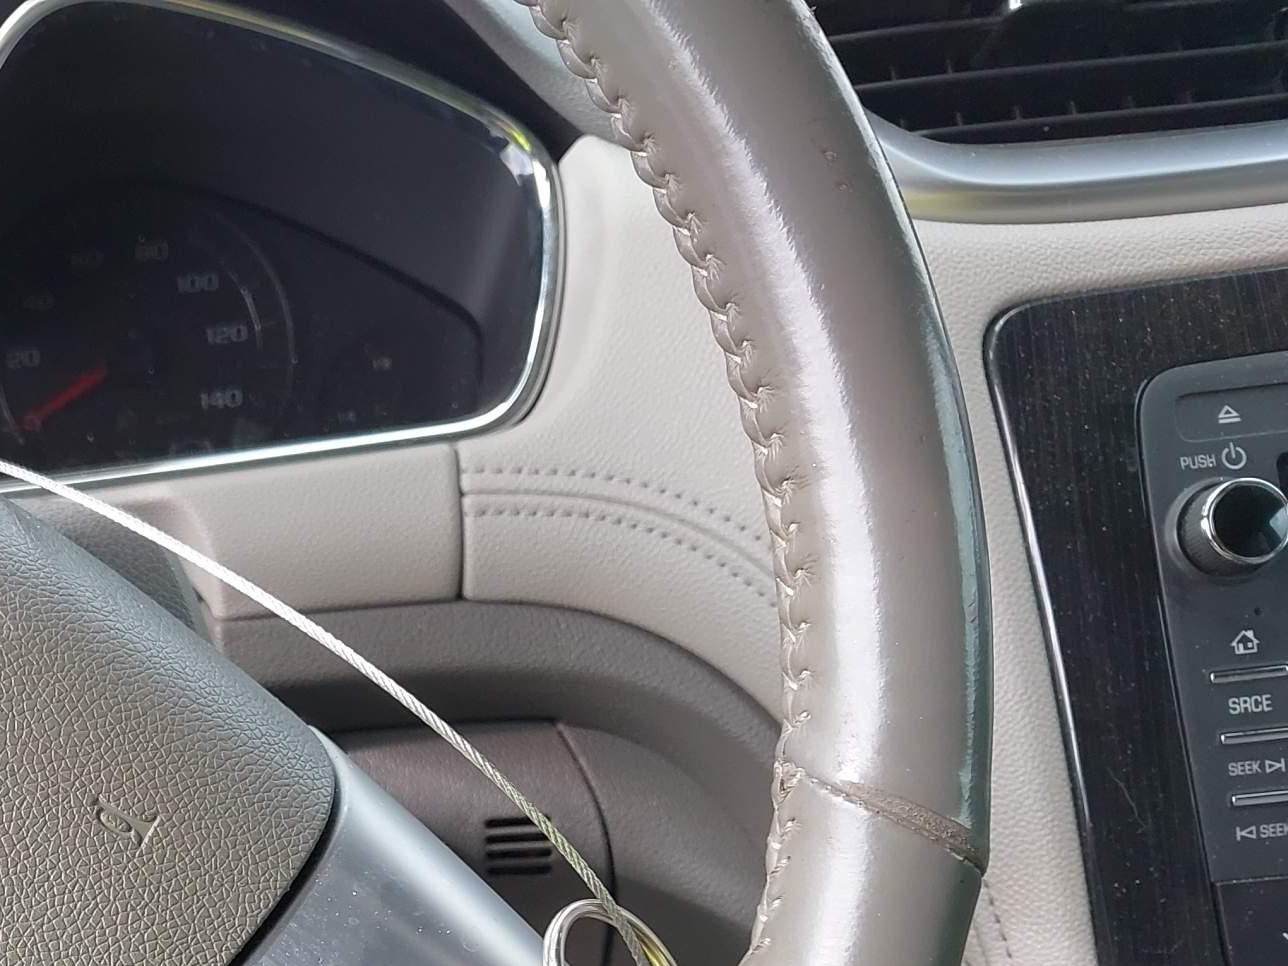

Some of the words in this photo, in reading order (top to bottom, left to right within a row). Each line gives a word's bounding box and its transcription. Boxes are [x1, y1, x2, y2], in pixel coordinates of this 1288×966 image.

[176, 271, 219, 293] 100
[205, 323, 249, 345] 120
[5, 347, 41, 368] 20
[200, 388, 244, 411] 140
[1180, 454, 1217, 471] PUSH
[1228, 694, 1273, 715] SRCE
[1228, 760, 1262, 776] SEEK
